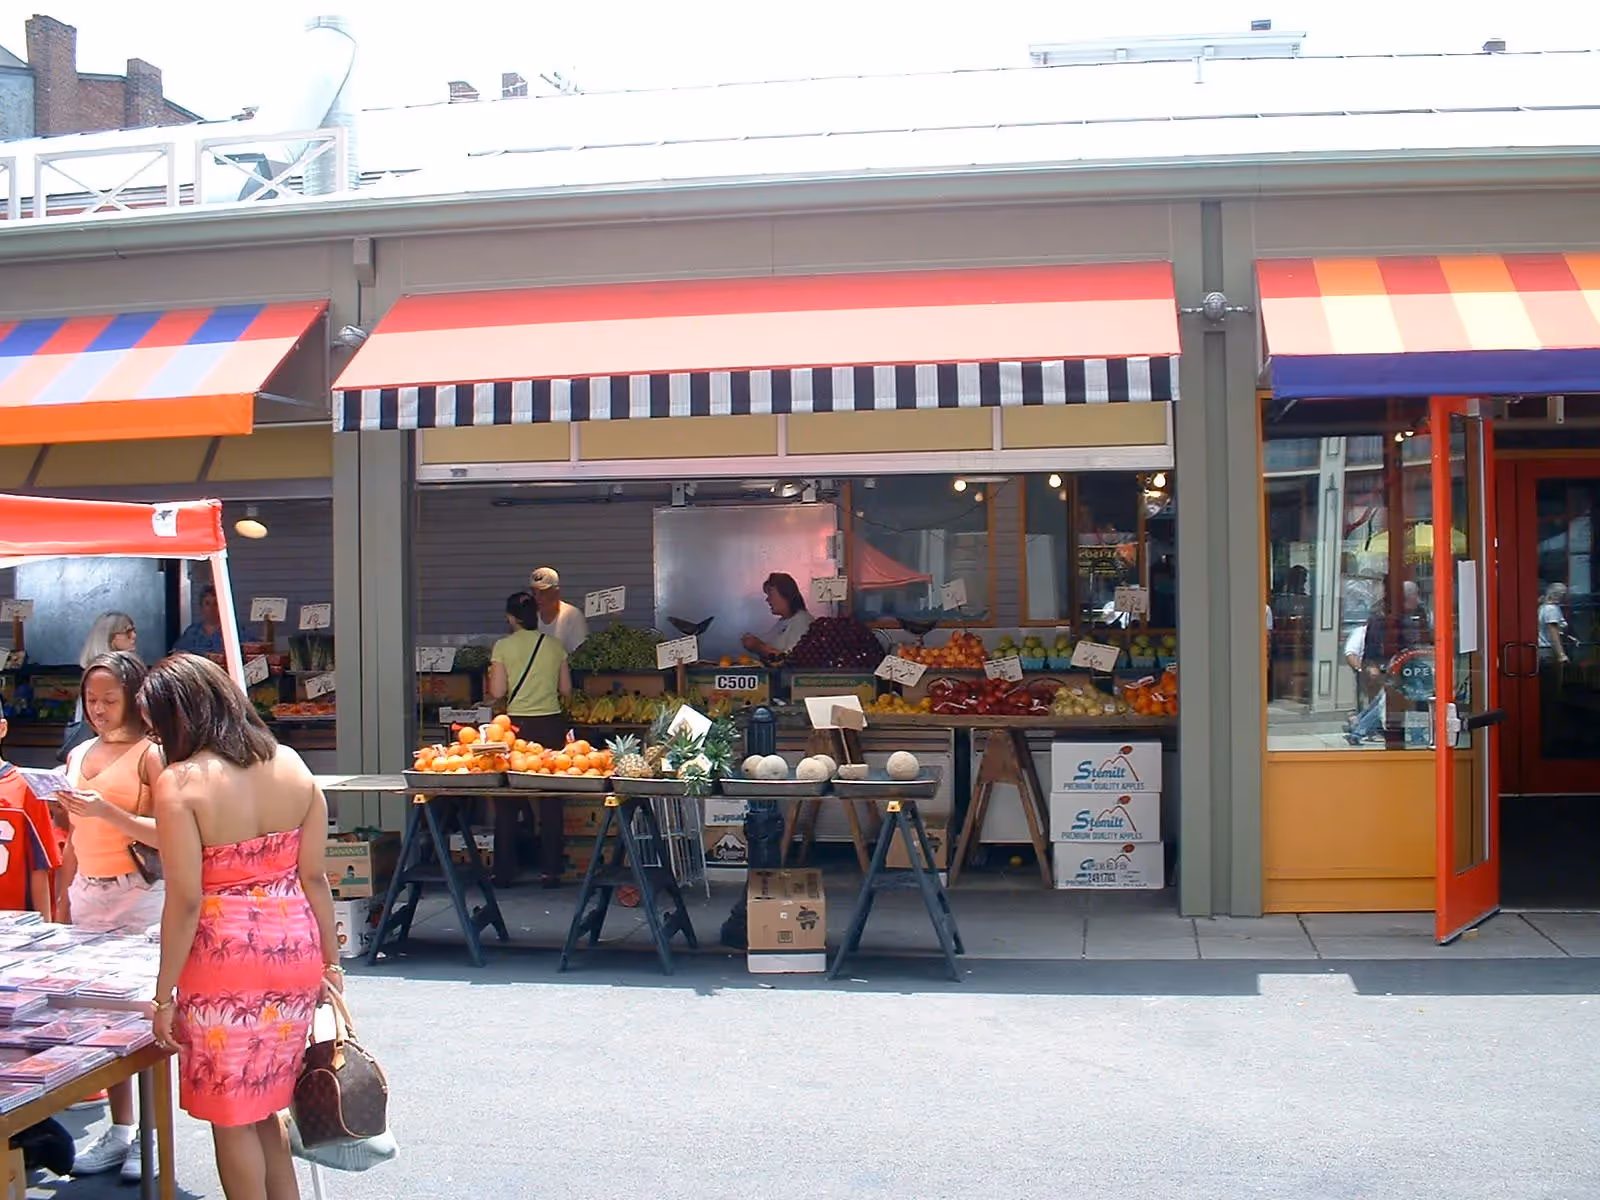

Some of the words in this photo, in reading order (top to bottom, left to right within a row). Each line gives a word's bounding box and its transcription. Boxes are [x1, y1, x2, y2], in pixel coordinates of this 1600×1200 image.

[1403, 668, 1435, 677] OPE
[718, 676, 756, 689] C500
[1074, 761, 1126, 781] Stemilt
[1072, 811, 1124, 830] Stemilt
